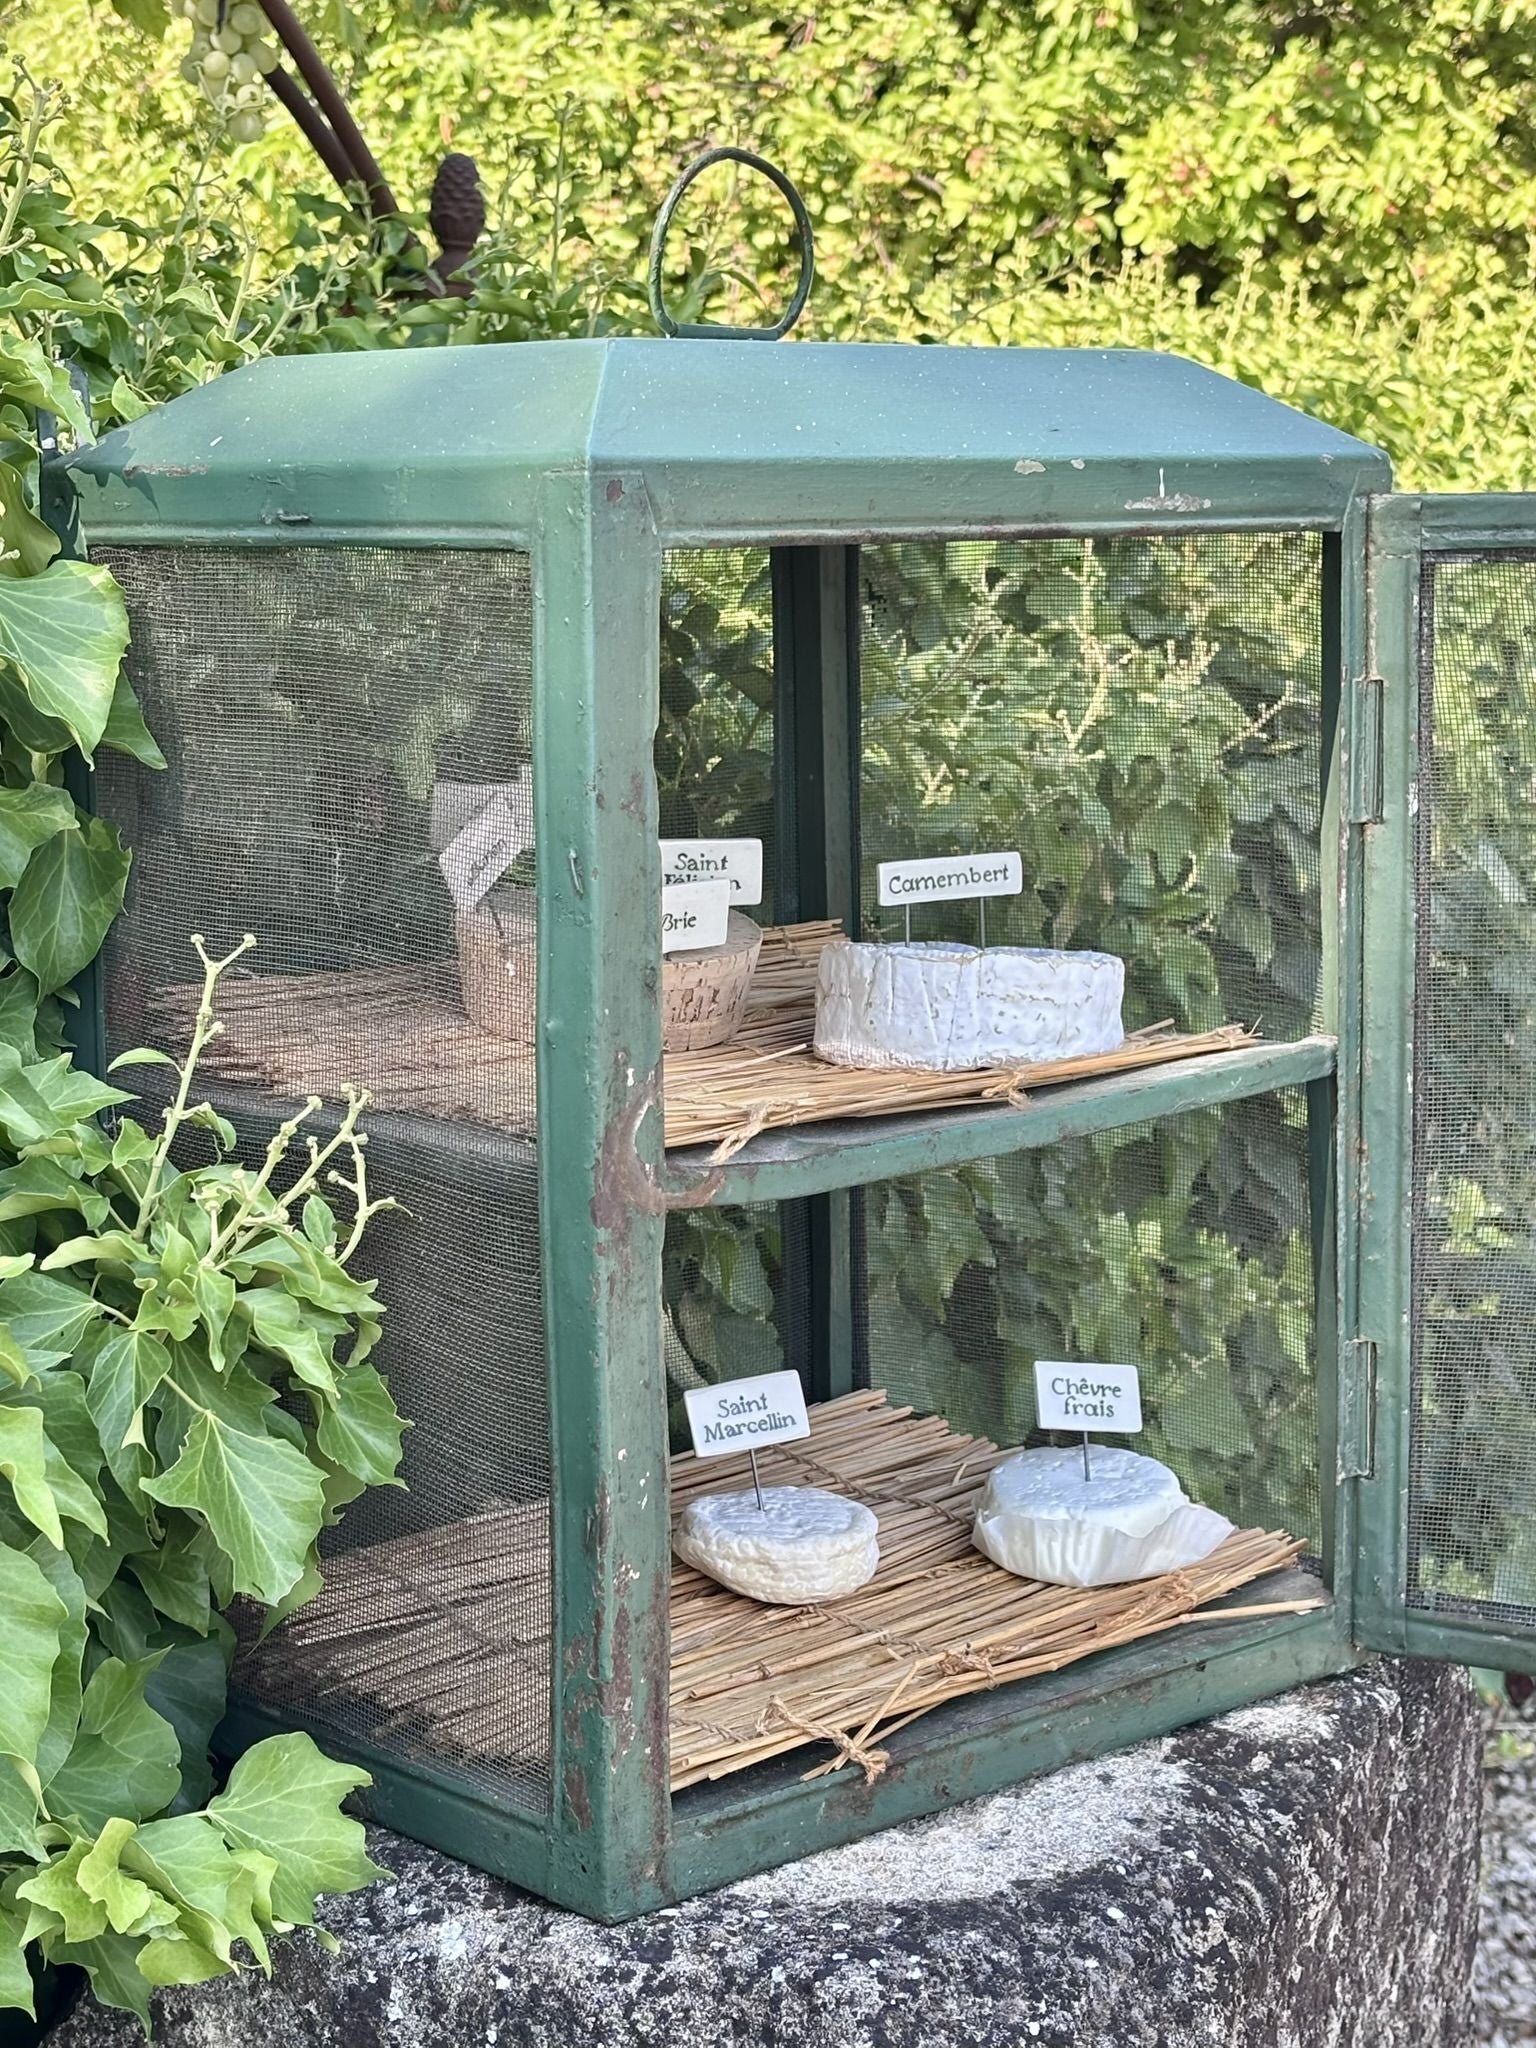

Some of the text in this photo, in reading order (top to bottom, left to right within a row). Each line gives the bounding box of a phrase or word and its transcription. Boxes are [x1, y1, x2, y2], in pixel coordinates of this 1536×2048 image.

[674, 852, 728, 872] Saint
[888, 863, 1009, 895] Camembert
[661, 911, 697, 932] Brie
[717, 1392, 768, 1419] Saint
[1064, 1395, 1115, 1418] frais
[703, 1412, 797, 1443] Marcellin
